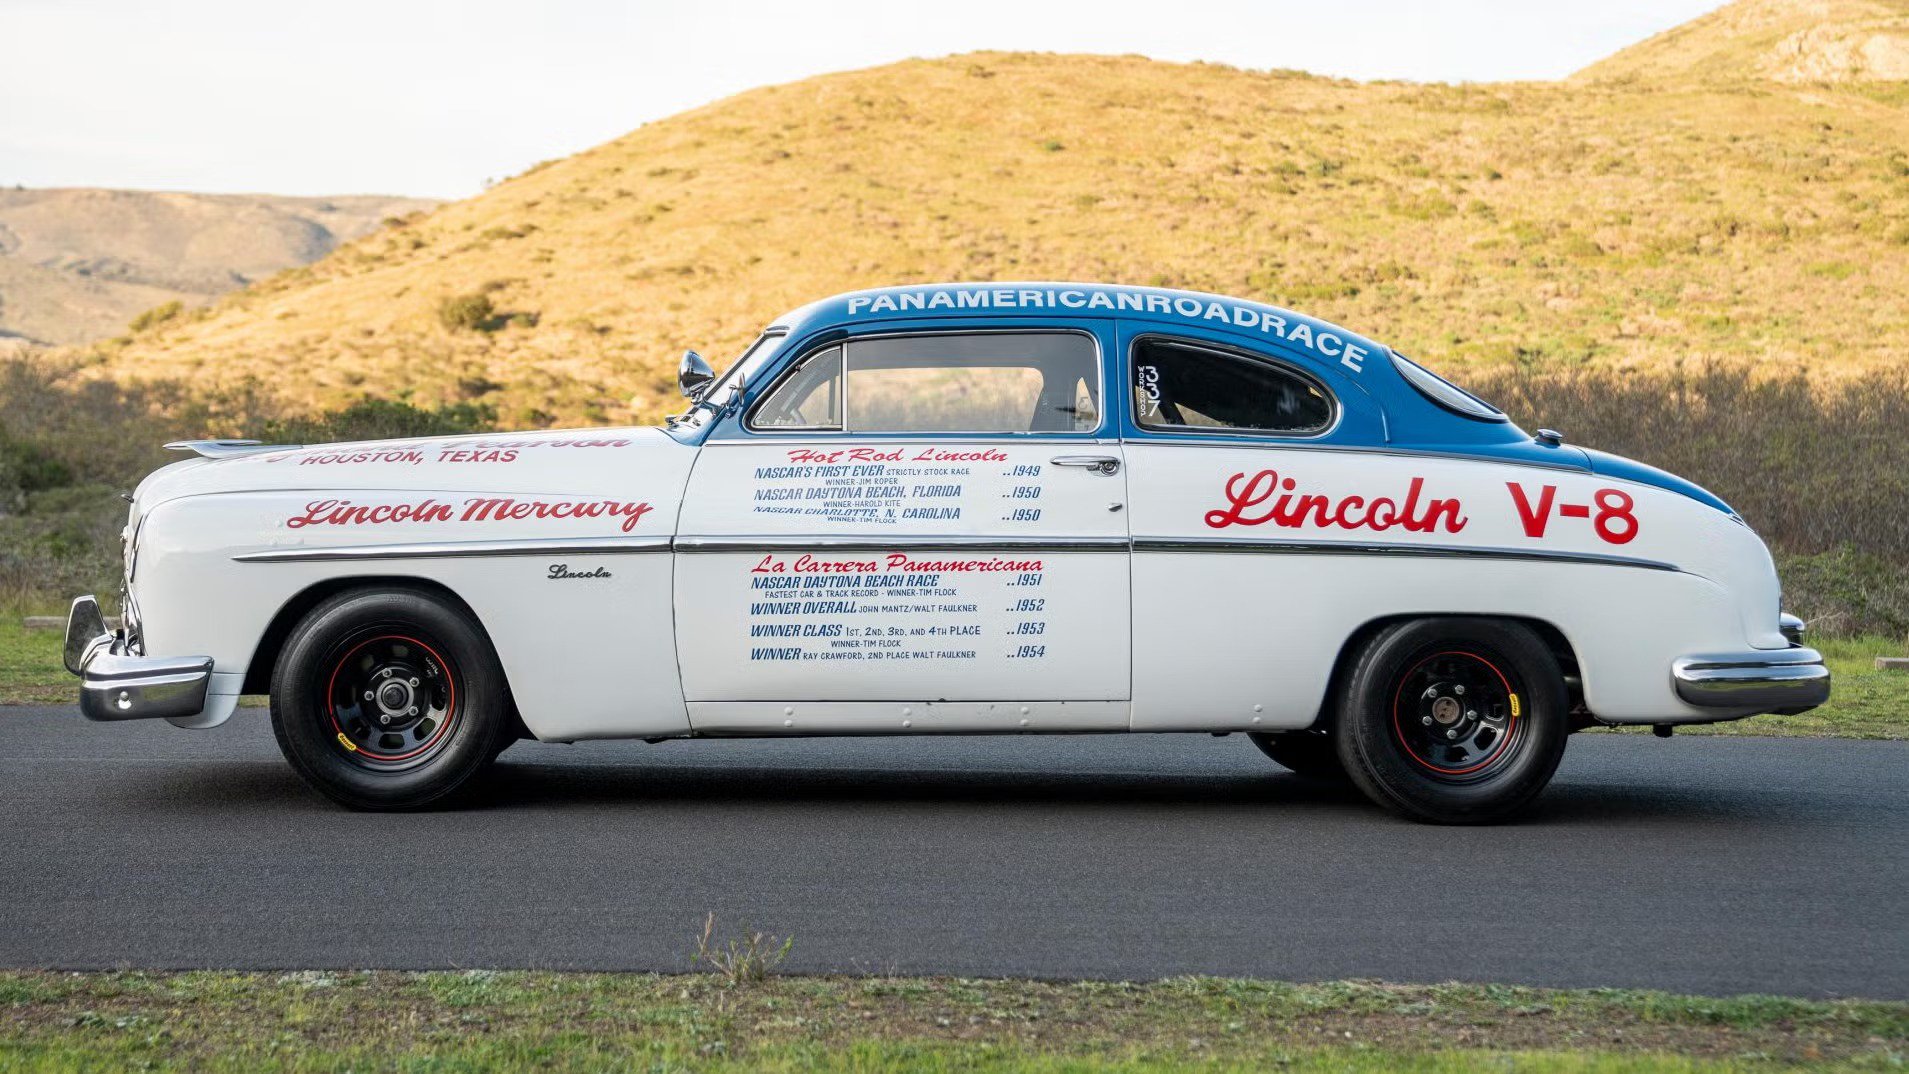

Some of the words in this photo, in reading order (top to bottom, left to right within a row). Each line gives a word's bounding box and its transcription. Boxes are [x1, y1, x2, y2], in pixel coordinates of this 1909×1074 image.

[1146, 366, 1160, 416] 337
[300, 451, 424, 465] HOUSTON,
[437, 450, 518, 462] TEXAS
[788, 450, 844, 463] Hot
[849, 448, 904, 461] Rod
[912, 448, 1008, 461] Lincoln
[755, 466, 812, 478] NASCAR'S
[815, 466, 850, 477] FIRST
[853, 465, 884, 476] EVER
[754, 488, 803, 500] NASCAR
[806, 486, 861, 499] DAYTONA
[912, 486, 961, 497] FLORIDA
[886, 509, 896, 517] N.
[902, 508, 960, 519] CAROLINA
[1204, 469, 1468, 533] Lincoln
[1506, 481, 1639, 544] V-8
[287, 500, 453, 529] Lincoln
[460, 499, 653, 532] Mercury
[751, 555, 786, 573] La
[794, 554, 879, 573] Carrera
[886, 554, 1043, 572] Panamericana
[548, 564, 611, 579] Lincoln
[751, 577, 801, 589] NASCAR
[804, 576, 861, 588] DAYTONA
[864, 575, 904, 587] BEACH
[906, 575, 939, 587] RACE
[751, 602, 800, 615] WINNER
[803, 601, 857, 614] OVERALL
[751, 625, 801, 636] WINNER
[803, 624, 842, 636] CLASS
[929, 627, 946, 635] 4TH
[950, 626, 981, 635] PLACE
[751, 648, 801, 660] WINNER
[821, 652, 864, 660] CRAWFORD,
[886, 651, 910, 659] PLACE
